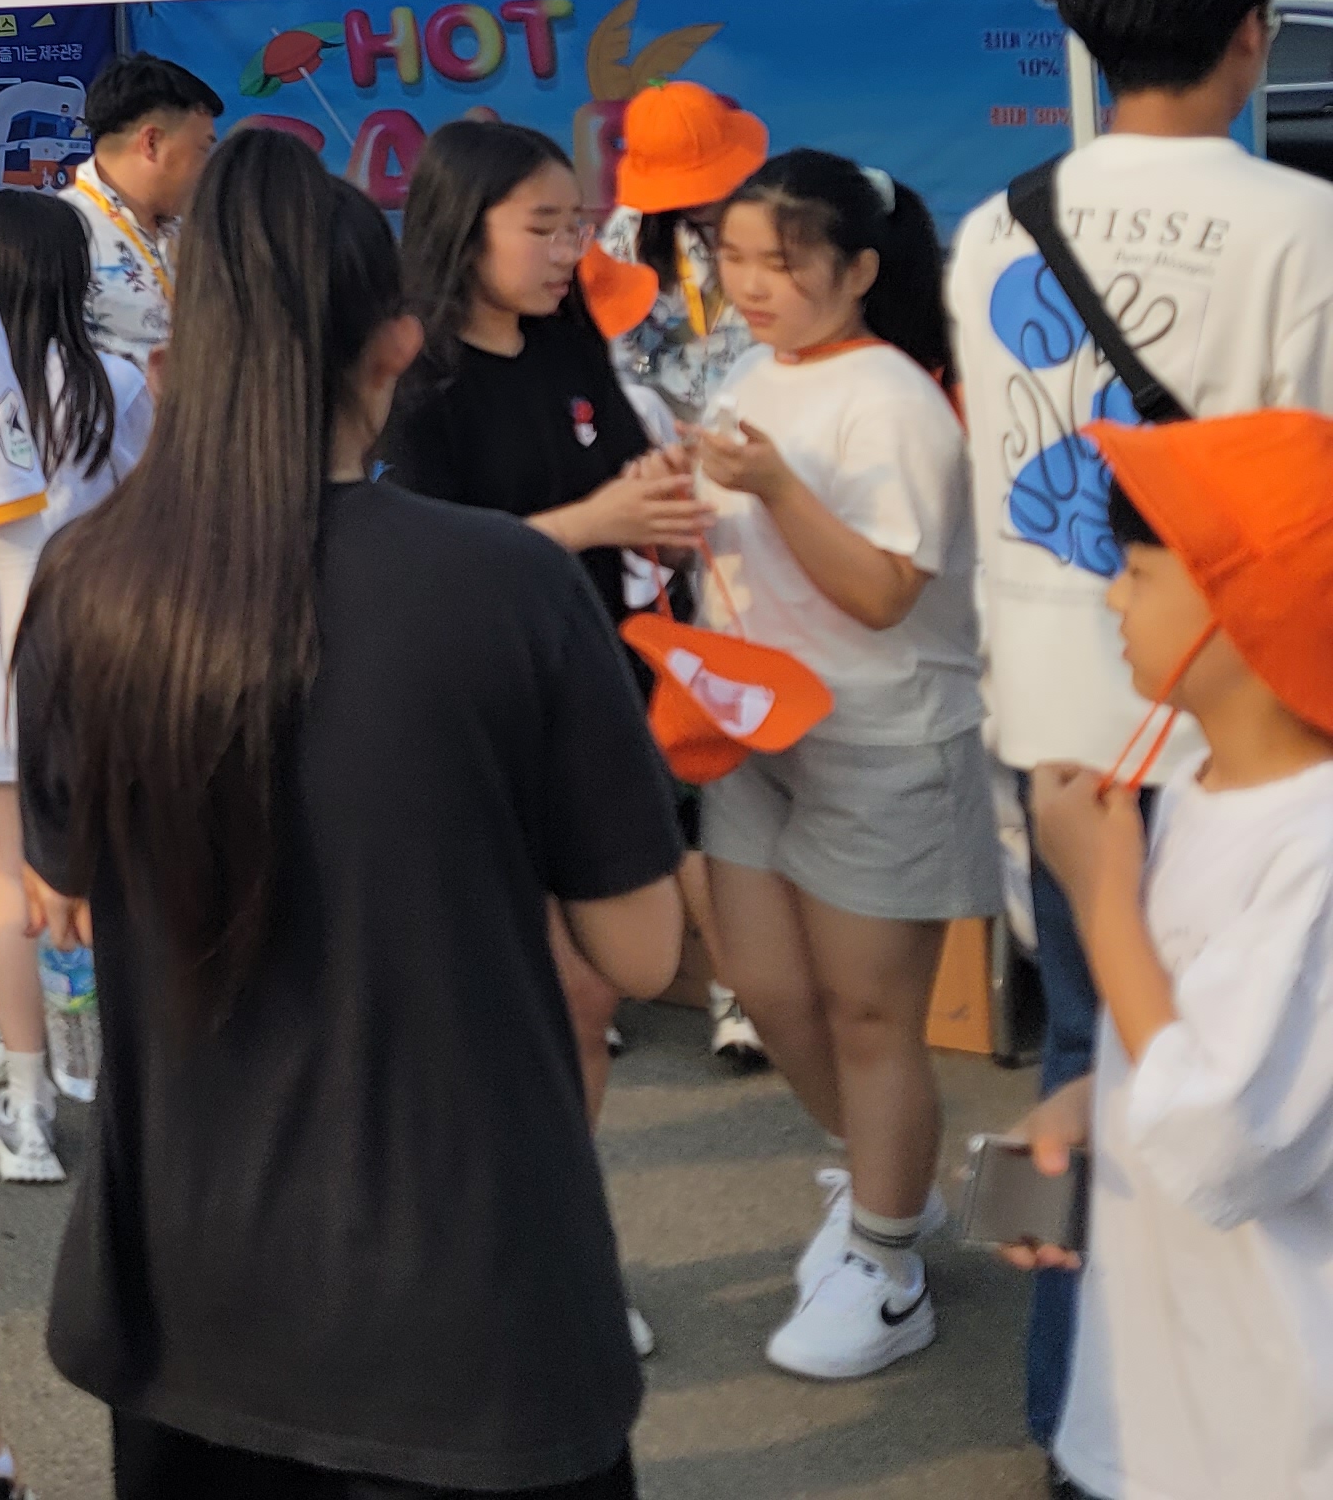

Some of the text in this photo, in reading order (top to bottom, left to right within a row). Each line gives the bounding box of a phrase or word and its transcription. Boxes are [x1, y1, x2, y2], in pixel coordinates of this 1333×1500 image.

[0, 45, 38, 63] 즐기는
[39, 43, 82, 62] 제주관광
[990, 207, 1230, 257] MTISSE
